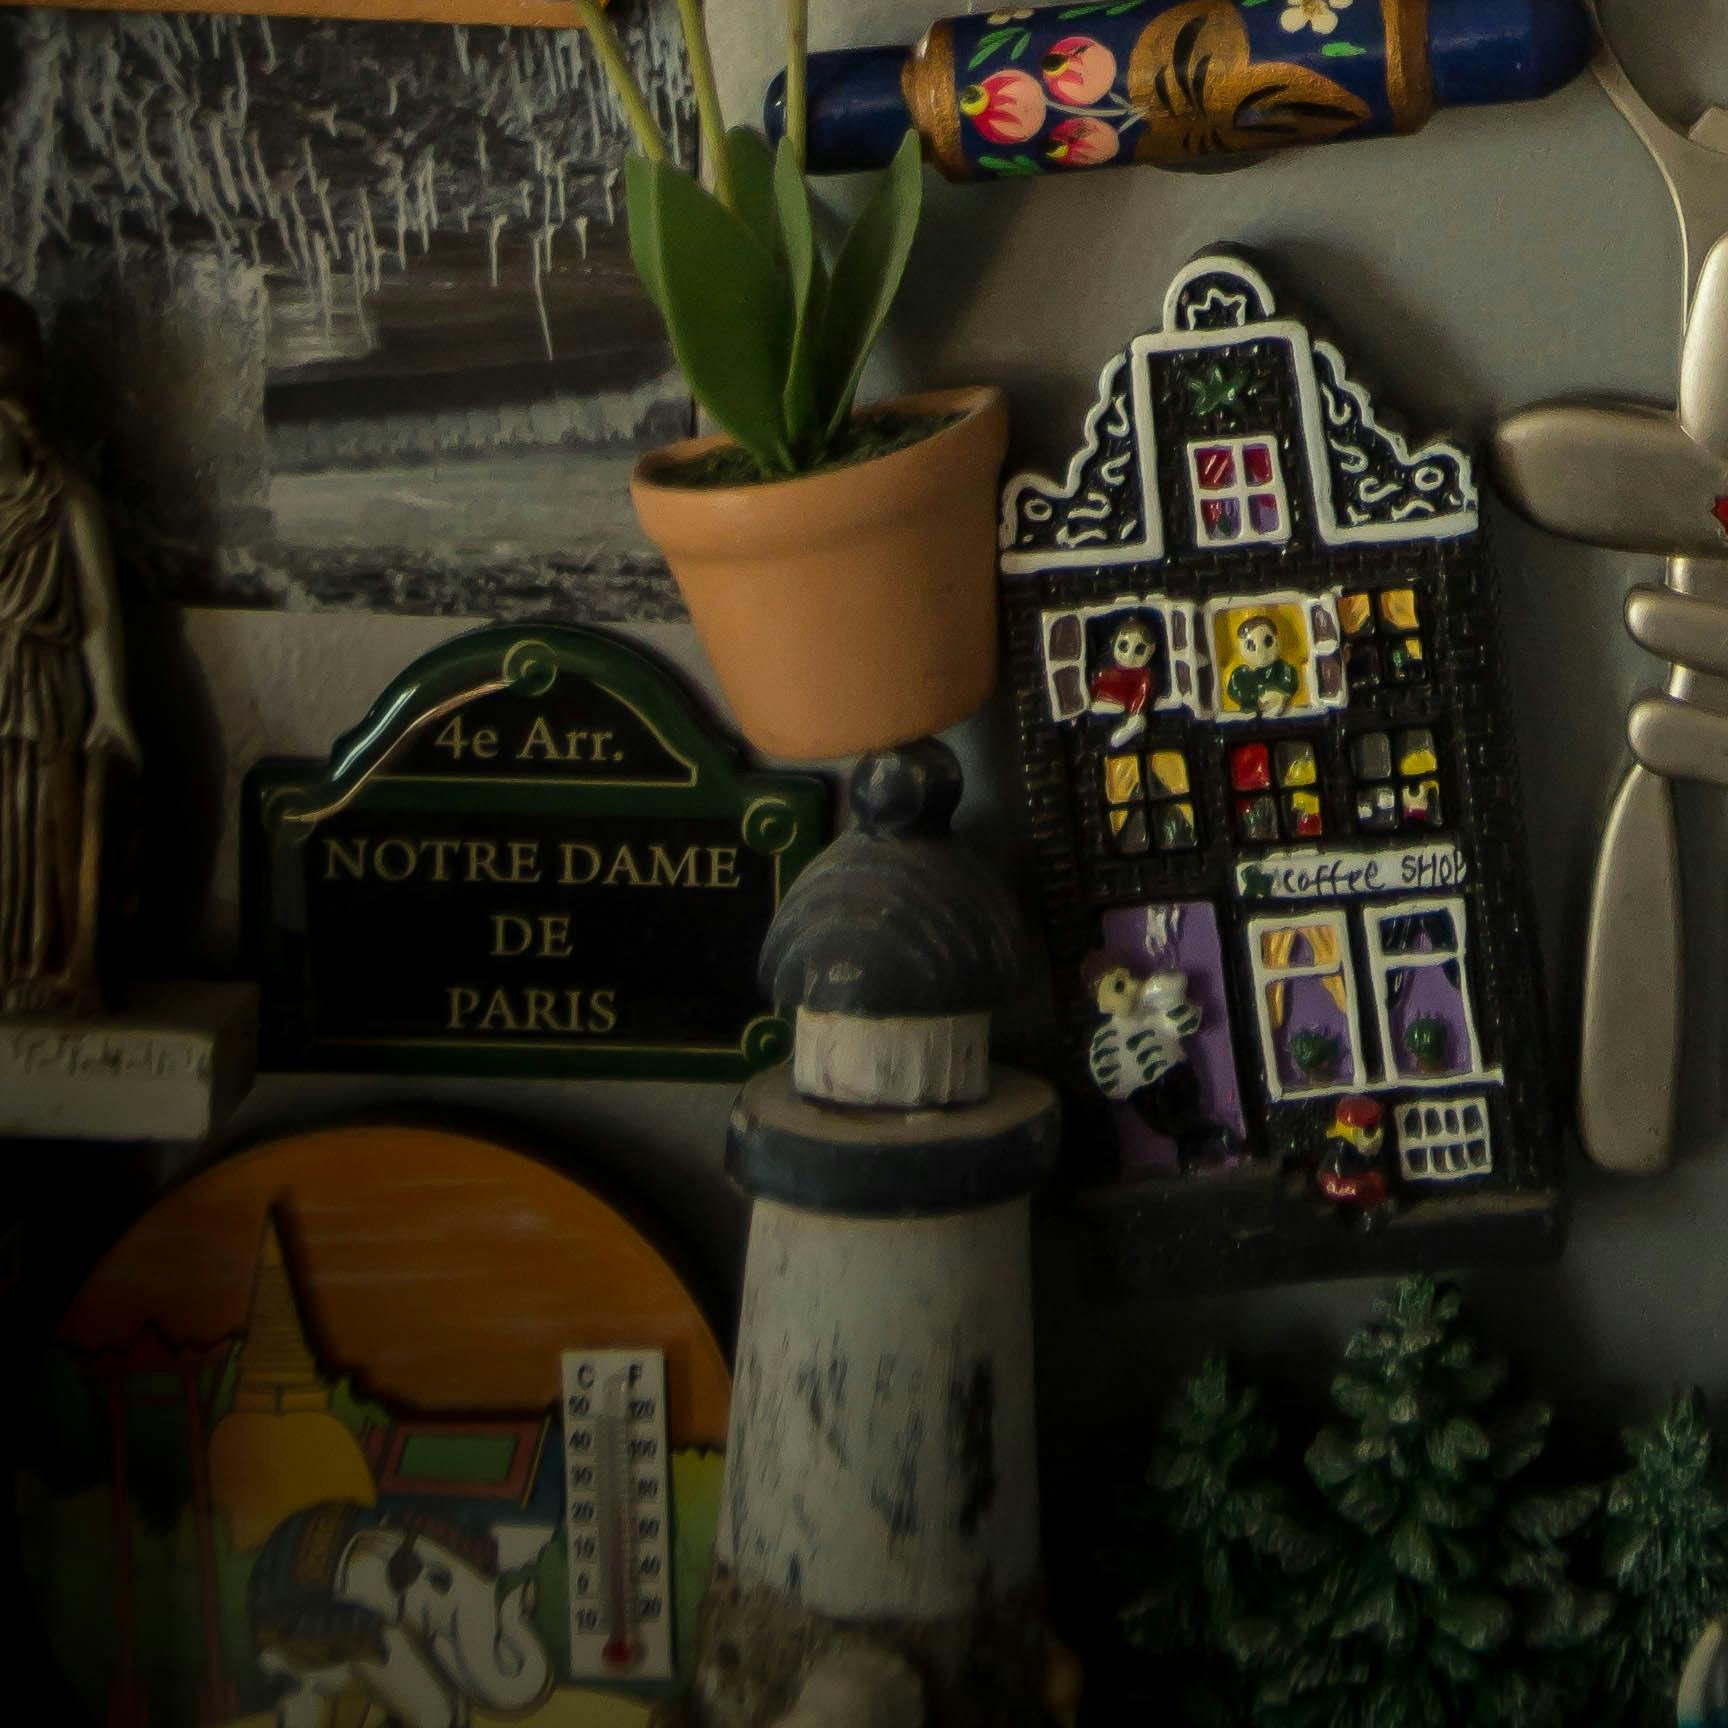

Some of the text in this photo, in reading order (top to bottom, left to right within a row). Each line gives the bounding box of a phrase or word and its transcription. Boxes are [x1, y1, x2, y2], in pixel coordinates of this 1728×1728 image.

[433, 715, 624, 763] 4e Arr.
[321, 838, 742, 889] NOTRE DAME
[1401, 850, 1468, 887] SHOP
[487, 913, 574, 961] DE
[444, 984, 619, 1033] PARIS
